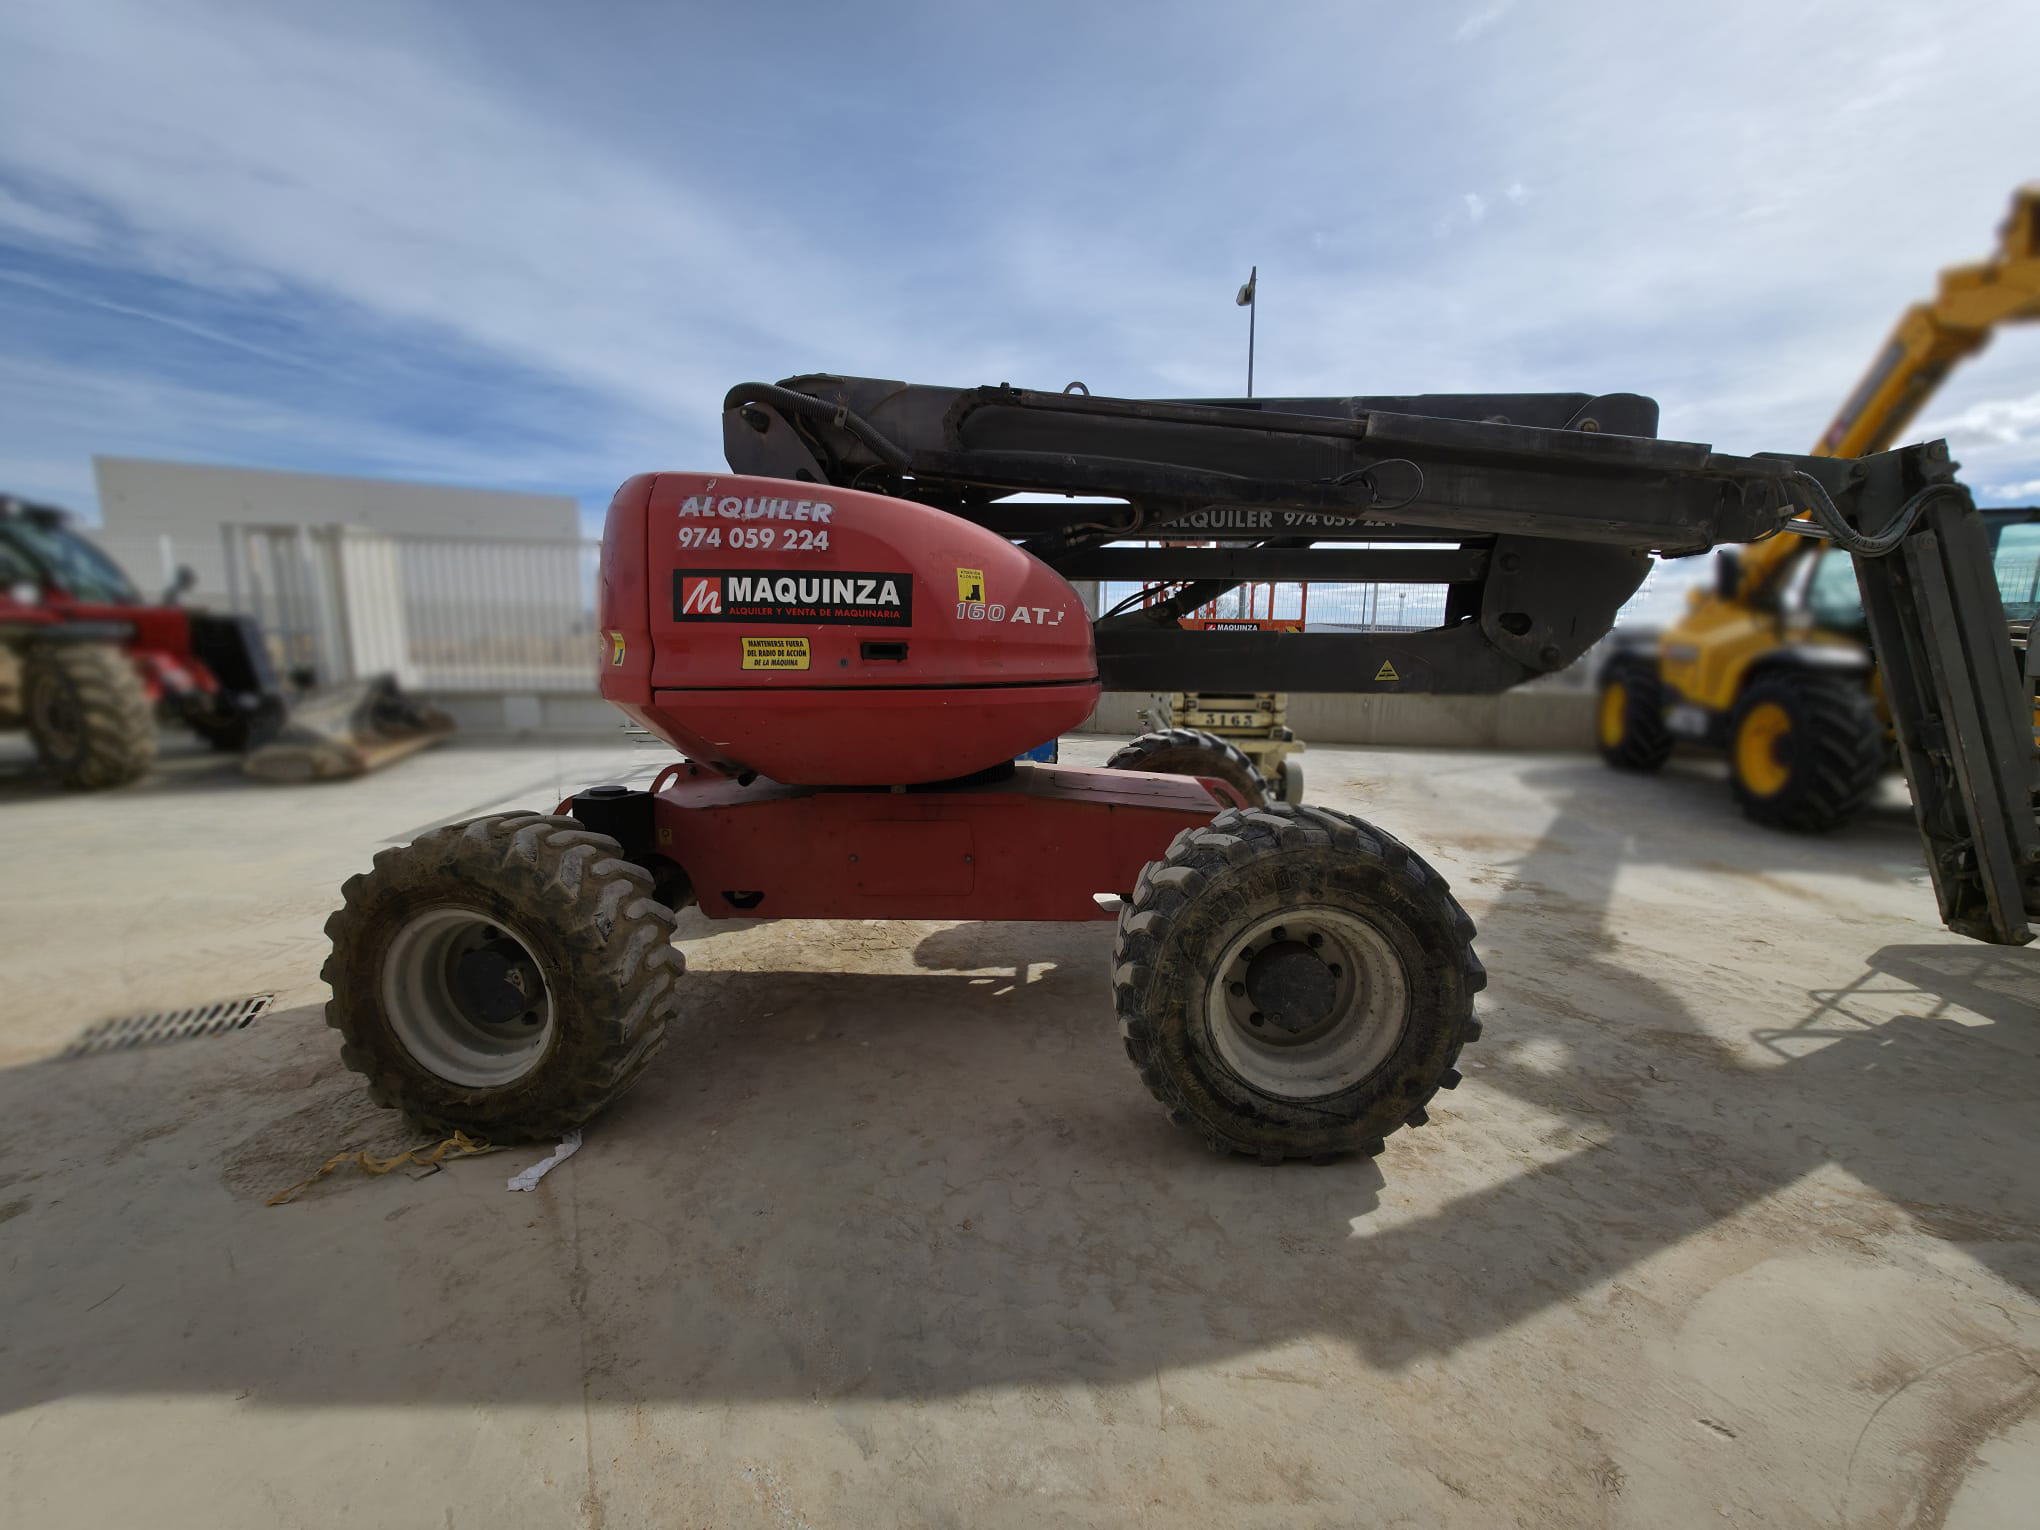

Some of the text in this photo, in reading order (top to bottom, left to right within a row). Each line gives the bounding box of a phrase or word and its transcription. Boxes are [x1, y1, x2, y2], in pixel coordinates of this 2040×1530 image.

[679, 496, 832, 523] ALQUILER
[1284, 512, 1318, 526] 974
[679, 527, 829, 551] 974 059 224
[728, 577, 900, 605] MAQUINZA
[730, 607, 901, 619] ALQUILER Y VENTA DE MAQUINARIA
[956, 602, 1005, 622] 160
[748, 640, 804, 648] MANTENERSE FUERA
[747, 649, 757, 657] DEL
[758, 649, 777, 657] RADIO
[777, 649, 785, 657] DE
